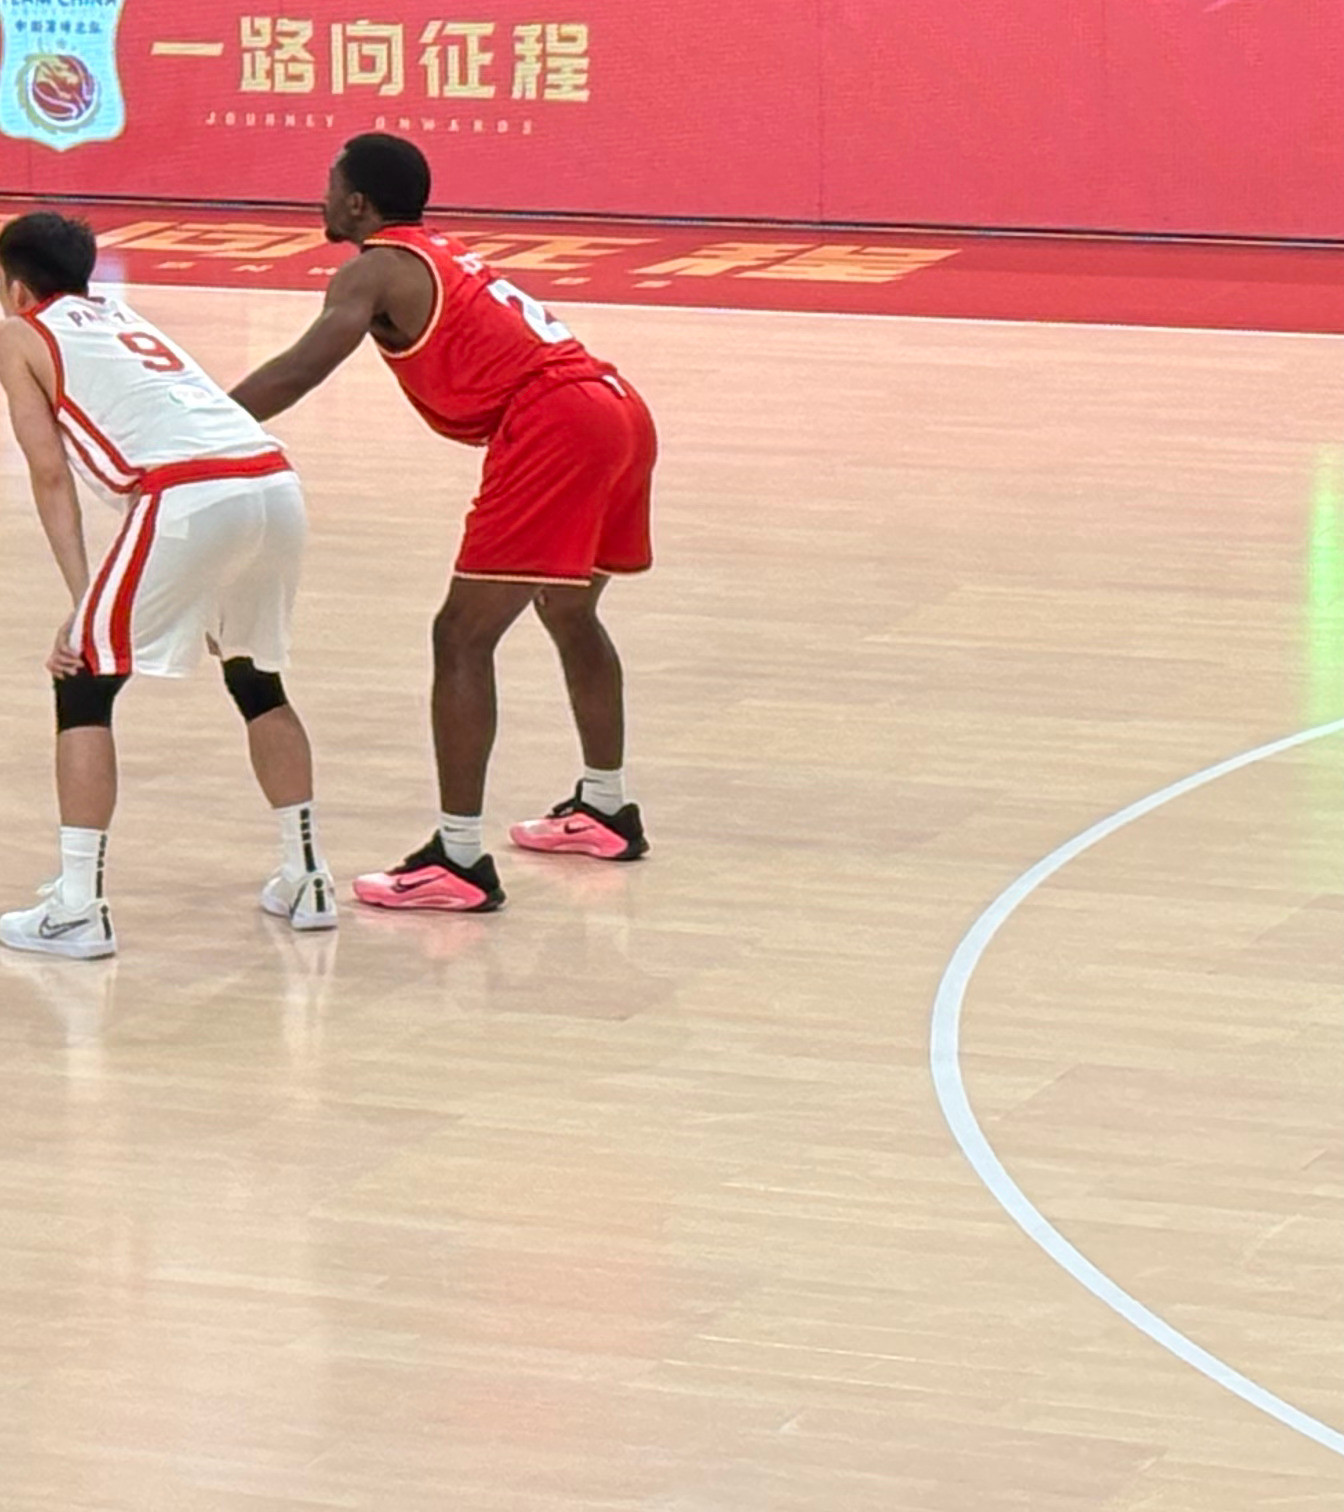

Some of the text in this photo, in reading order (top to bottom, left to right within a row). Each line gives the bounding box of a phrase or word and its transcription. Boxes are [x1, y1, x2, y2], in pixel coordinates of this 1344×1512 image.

[150, 15, 591, 103] 一路向征程
[206, 110, 336, 129] JOURNEY
[116, 331, 185, 373] 9
